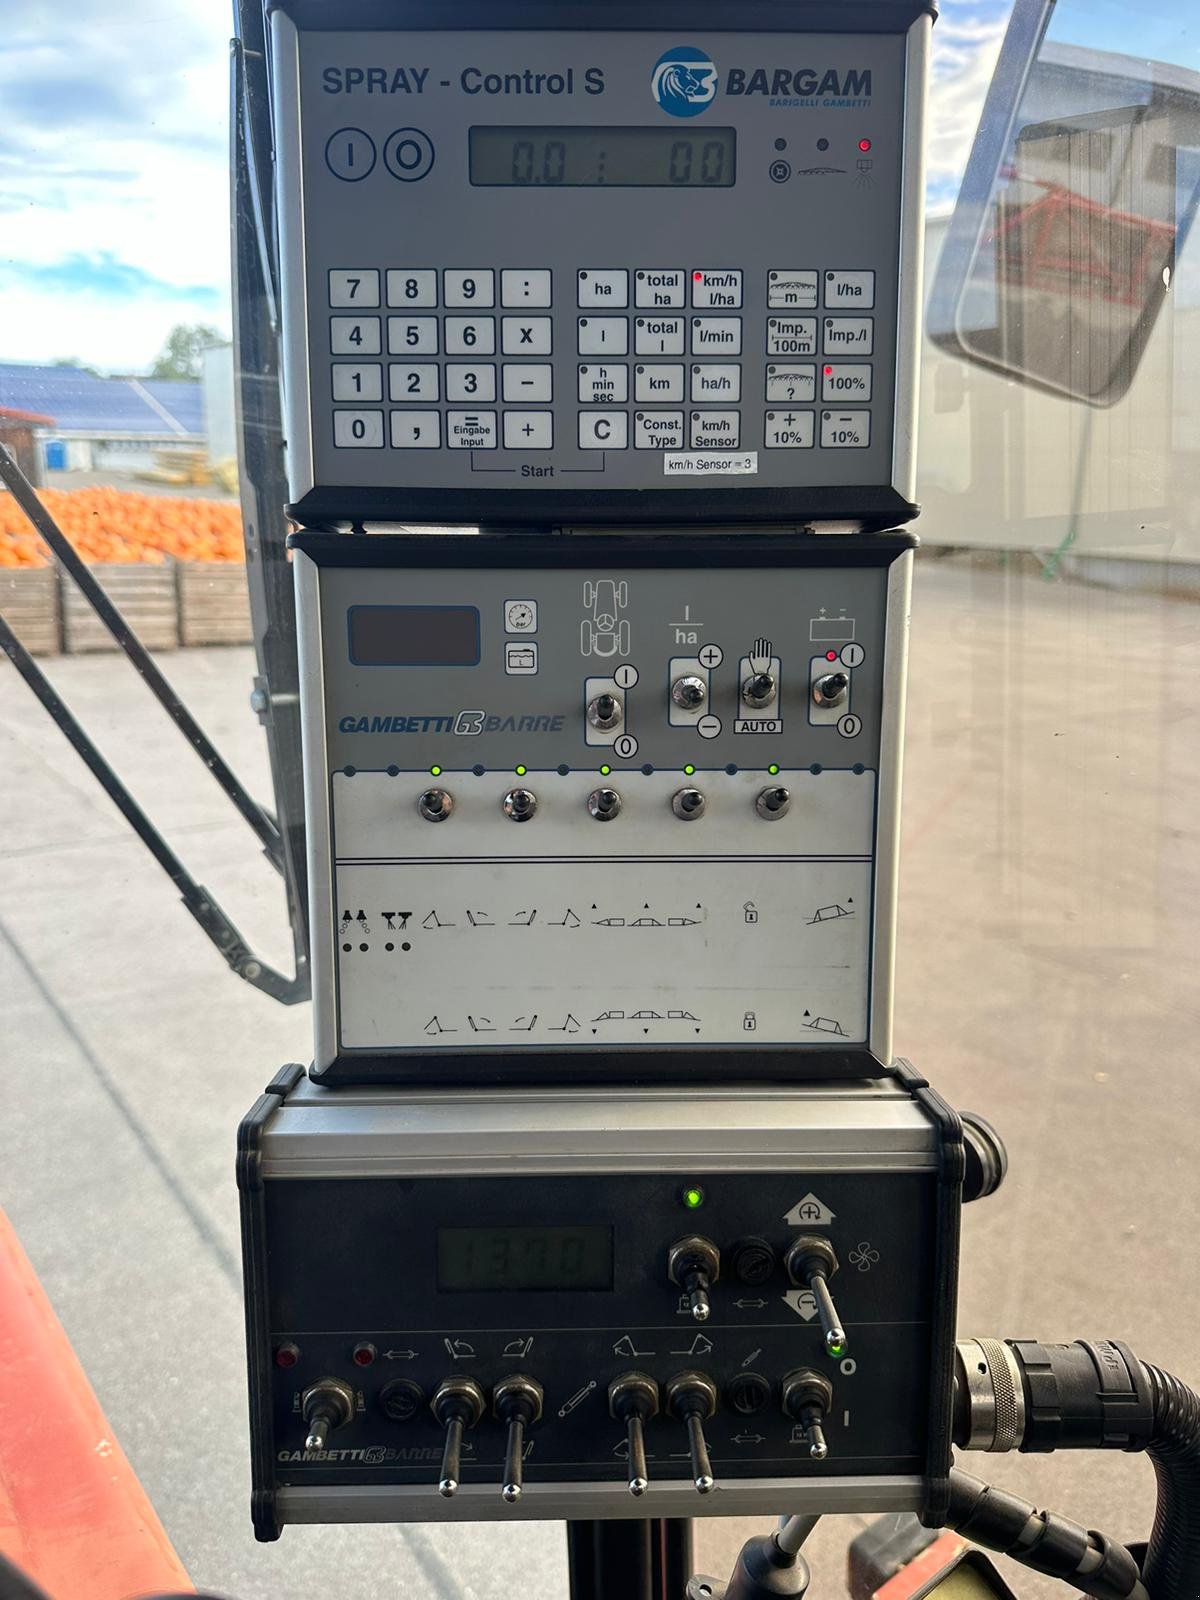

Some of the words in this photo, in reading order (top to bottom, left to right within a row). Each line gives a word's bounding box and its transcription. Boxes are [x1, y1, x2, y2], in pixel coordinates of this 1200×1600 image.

[321, 67, 430, 95] SPRAY
[460, 67, 573, 95] Control
[584, 67, 605, 95] S
[726, 68, 872, 97] BARGAM
[769, 98, 819, 108] BARIGELLI
[822, 98, 872, 108] GAMBETTI
[647, 274, 678, 287] total
[703, 274, 737, 287] km/h
[346, 278, 361, 299] 7
[405, 278, 419, 299] 8
[462, 278, 476, 299] 9
[595, 283, 612, 295] ha
[654, 293, 671, 306] ha
[785, 293, 798, 303] m
[647, 321, 678, 334] total
[777, 322, 807, 336] Imp.
[348, 325, 363, 346] 4
[406, 325, 420, 346] 5
[463, 325, 477, 346] 6
[773, 340, 811, 353] 100m
[599, 367, 607, 378] h
[351, 373, 362, 393] 1
[407, 373, 421, 393] 2
[463, 373, 478, 393] 3
[592, 379, 615, 390] min
[649, 378, 670, 390] km
[701, 378, 731, 390] ha/h
[829, 377, 865, 390] 100%
[592, 392, 614, 402] sec
[786, 388, 795, 400] ?
[351, 419, 366, 439] 0
[453, 425, 491, 437] Eingabe
[594, 418, 611, 440] C
[643, 419, 682, 431] Const.
[702, 420, 730, 432] km/h
[460, 437, 484, 448] Input
[648, 434, 677, 448] Type
[695, 435, 737, 447] Sensor
[773, 431, 802, 444] 10%
[830, 431, 860, 444] 10%
[520, 463, 555, 478] Start
[668, 459, 694, 470] km/h
[696, 459, 732, 470] Sensor
[744, 458, 752, 469] 3
[675, 628, 698, 644] ha
[338, 715, 454, 733] GAMBETTI
[485, 714, 565, 732] BARRE
[740, 721, 777, 732] AUTO
[277, 1449, 364, 1463] GAMBETTI
